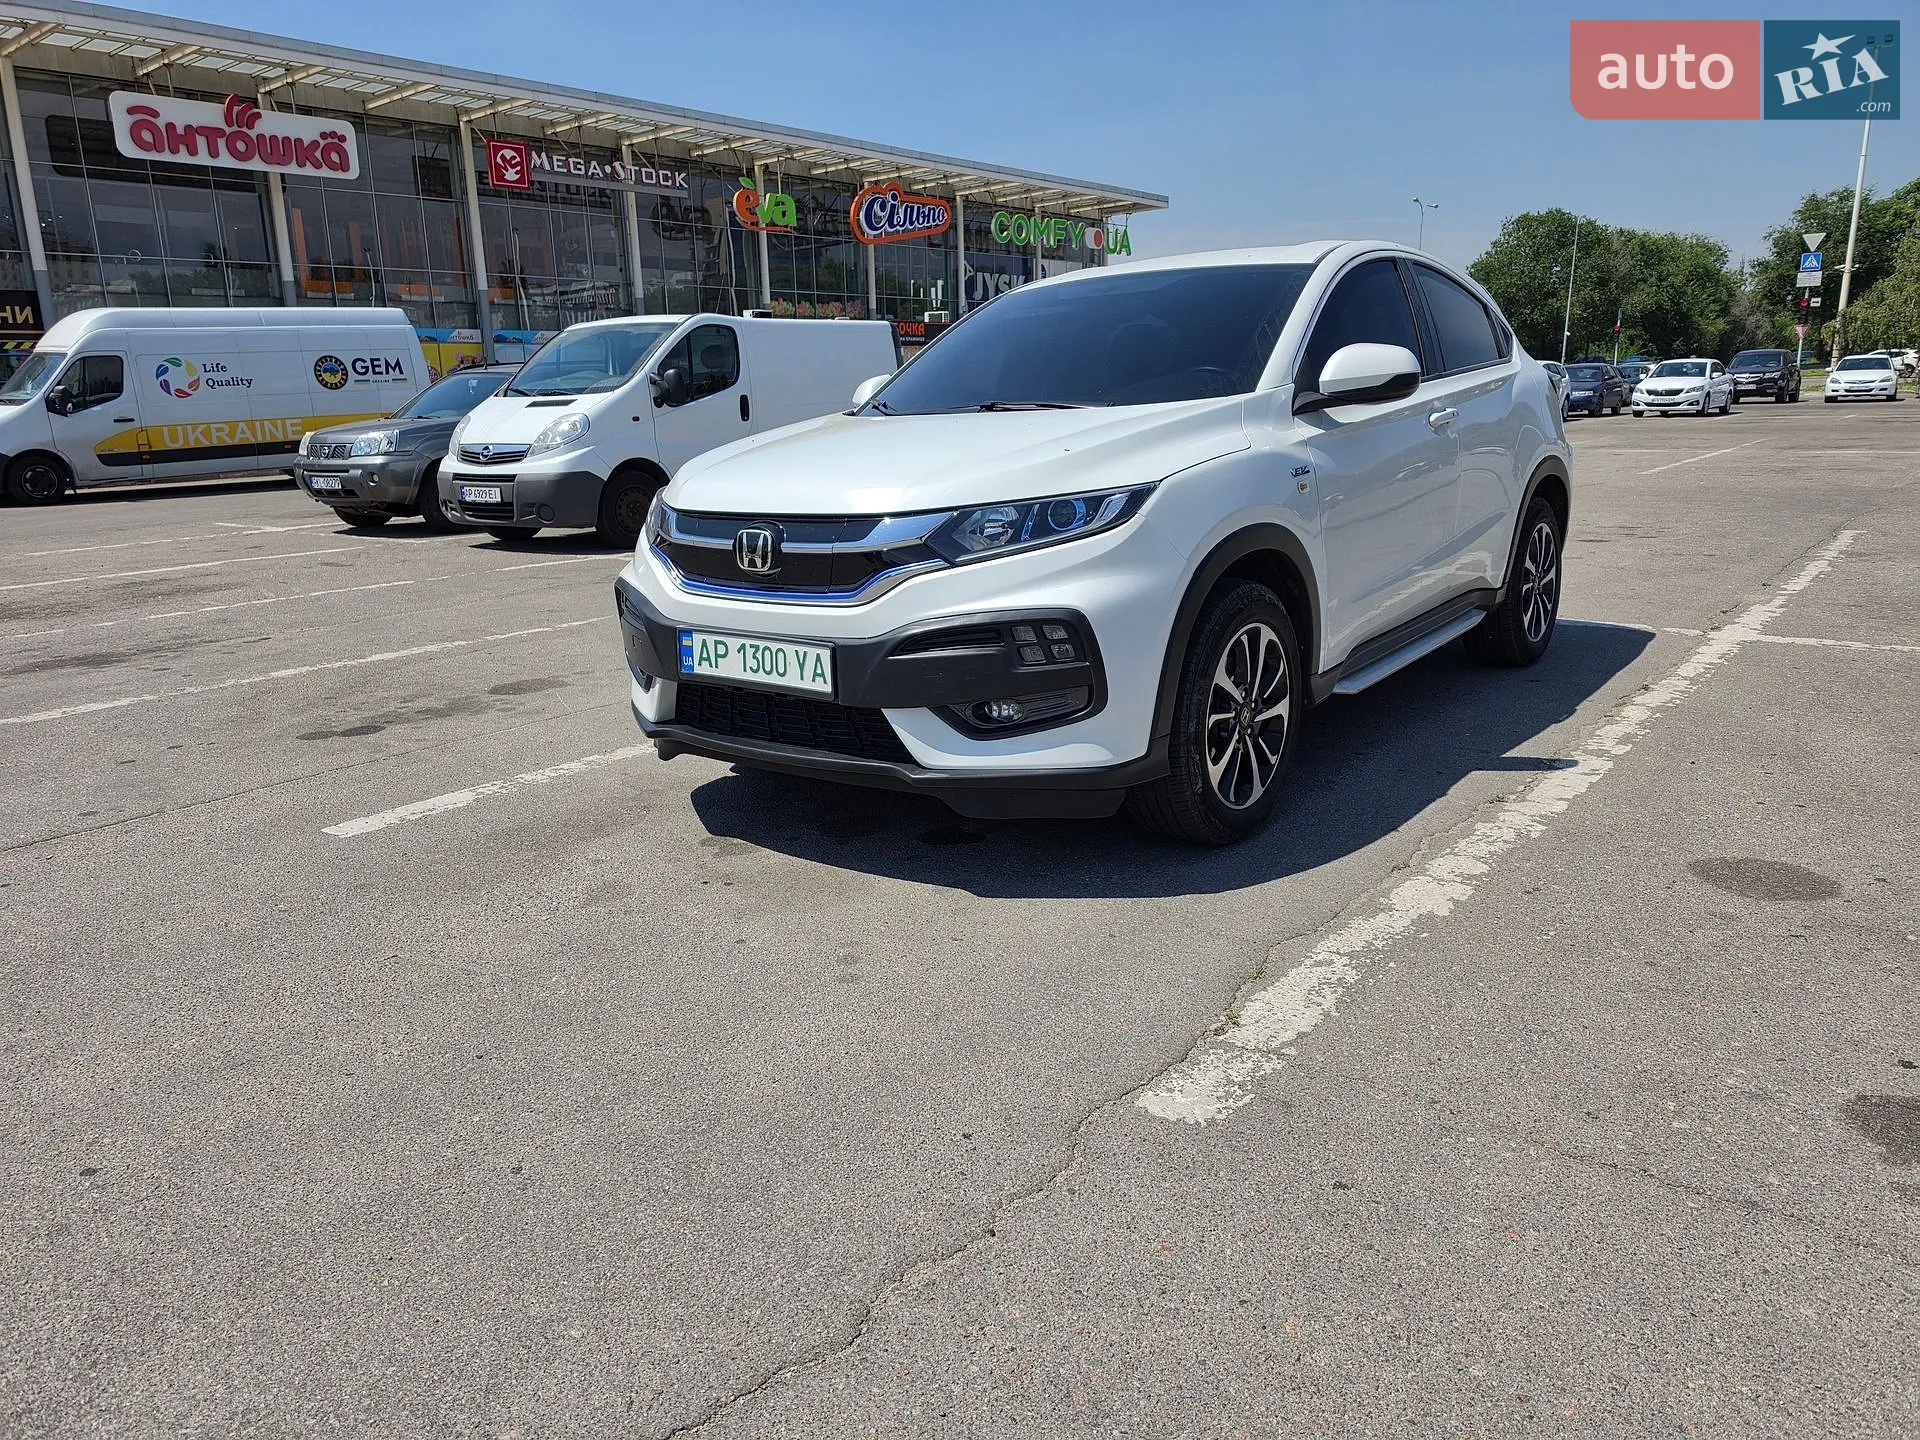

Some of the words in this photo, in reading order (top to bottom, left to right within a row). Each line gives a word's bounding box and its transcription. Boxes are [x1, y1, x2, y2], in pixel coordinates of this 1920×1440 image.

[733, 187, 798, 228] eva
[861, 191, 948, 235] Сільпо
[896, 322, 926, 336] ОЧКА
[202, 363, 227, 373] Life
[351, 357, 405, 376] GEM
[205, 377, 253, 390] Quality
[162, 418, 304, 449] UKRAINE
[683, 655, 693, 666] UA
[697, 638, 729, 669] AP
[736, 642, 788, 678] 1300
[794, 649, 828, 684] YA
